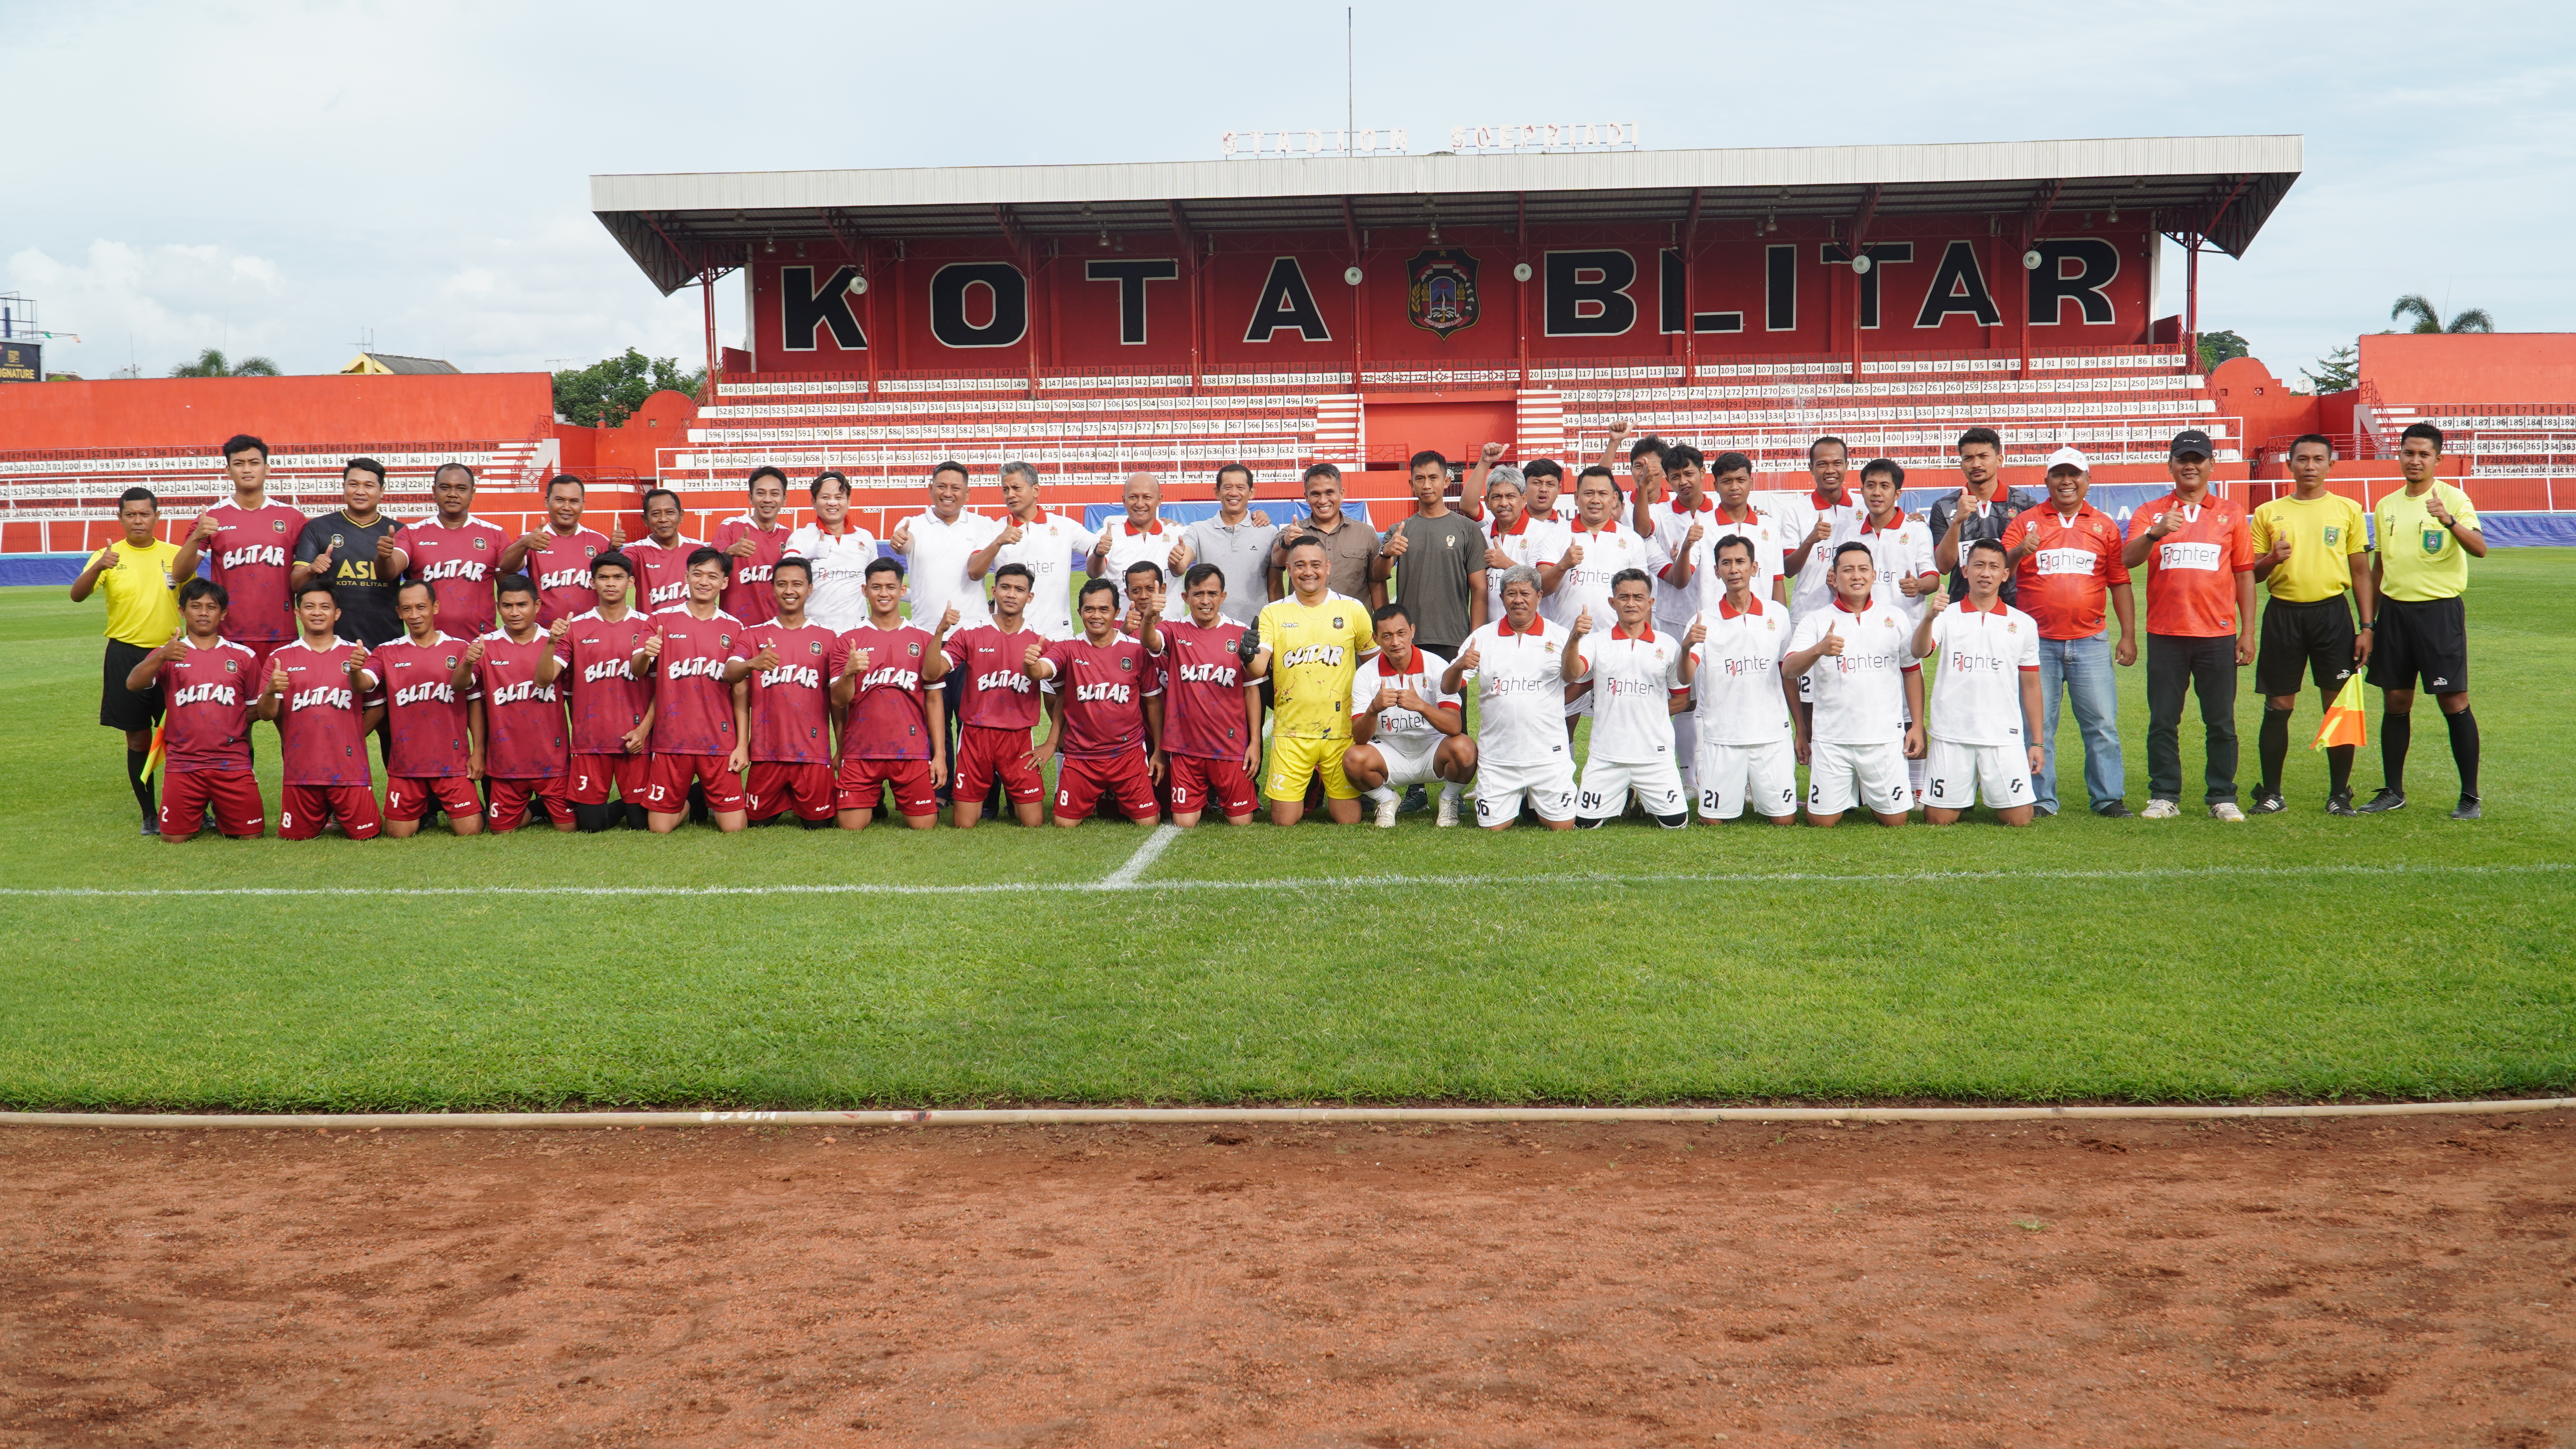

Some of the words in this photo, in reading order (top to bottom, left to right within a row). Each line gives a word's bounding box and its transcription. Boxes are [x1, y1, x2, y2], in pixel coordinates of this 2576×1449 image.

[1221, 127, 1408, 156] STADION
[1450, 121, 1639, 151] SOEPRIADI
[781, 258, 1332, 351] KOTA
[1544, 237, 2120, 336] BLITAR
[223, 545, 284, 569] BLITAR
[2040, 554, 2092, 571] Fighter
[2163, 545, 2217, 565] Fighter
[423, 559, 486, 582] BLITAR
[649, 582, 690, 606] BLITA
[1283, 644, 1344, 668] BLITAR
[1725, 655, 1770, 677] Fighter
[1837, 652, 1889, 674] Fighter
[1953, 652, 2003, 673] Fighter
[760, 664, 818, 688] BLITAR
[861, 667, 918, 691] BLITAR
[977, 670, 1031, 693] BLITAR
[1180, 664, 1236, 687] BLITAR
[1491, 676, 1542, 696] Fighter
[175, 683, 235, 706] BLITAR
[1077, 682, 1130, 703] BLITAR
[1608, 677, 1653, 696] Fighter
[292, 686, 351, 711] BLITAR
[578, 776, 587, 791] 3
[957, 773, 964, 788] 5
[1271, 773, 1285, 790] 22
[390, 791, 400, 808] 4
[648, 784, 665, 801] 13
[1060, 790, 1068, 806] 8
[1173, 787, 1186, 803] 20
[1581, 791, 1601, 809] 94
[1704, 789, 1719, 809] 21
[162, 806, 168, 822] 2
